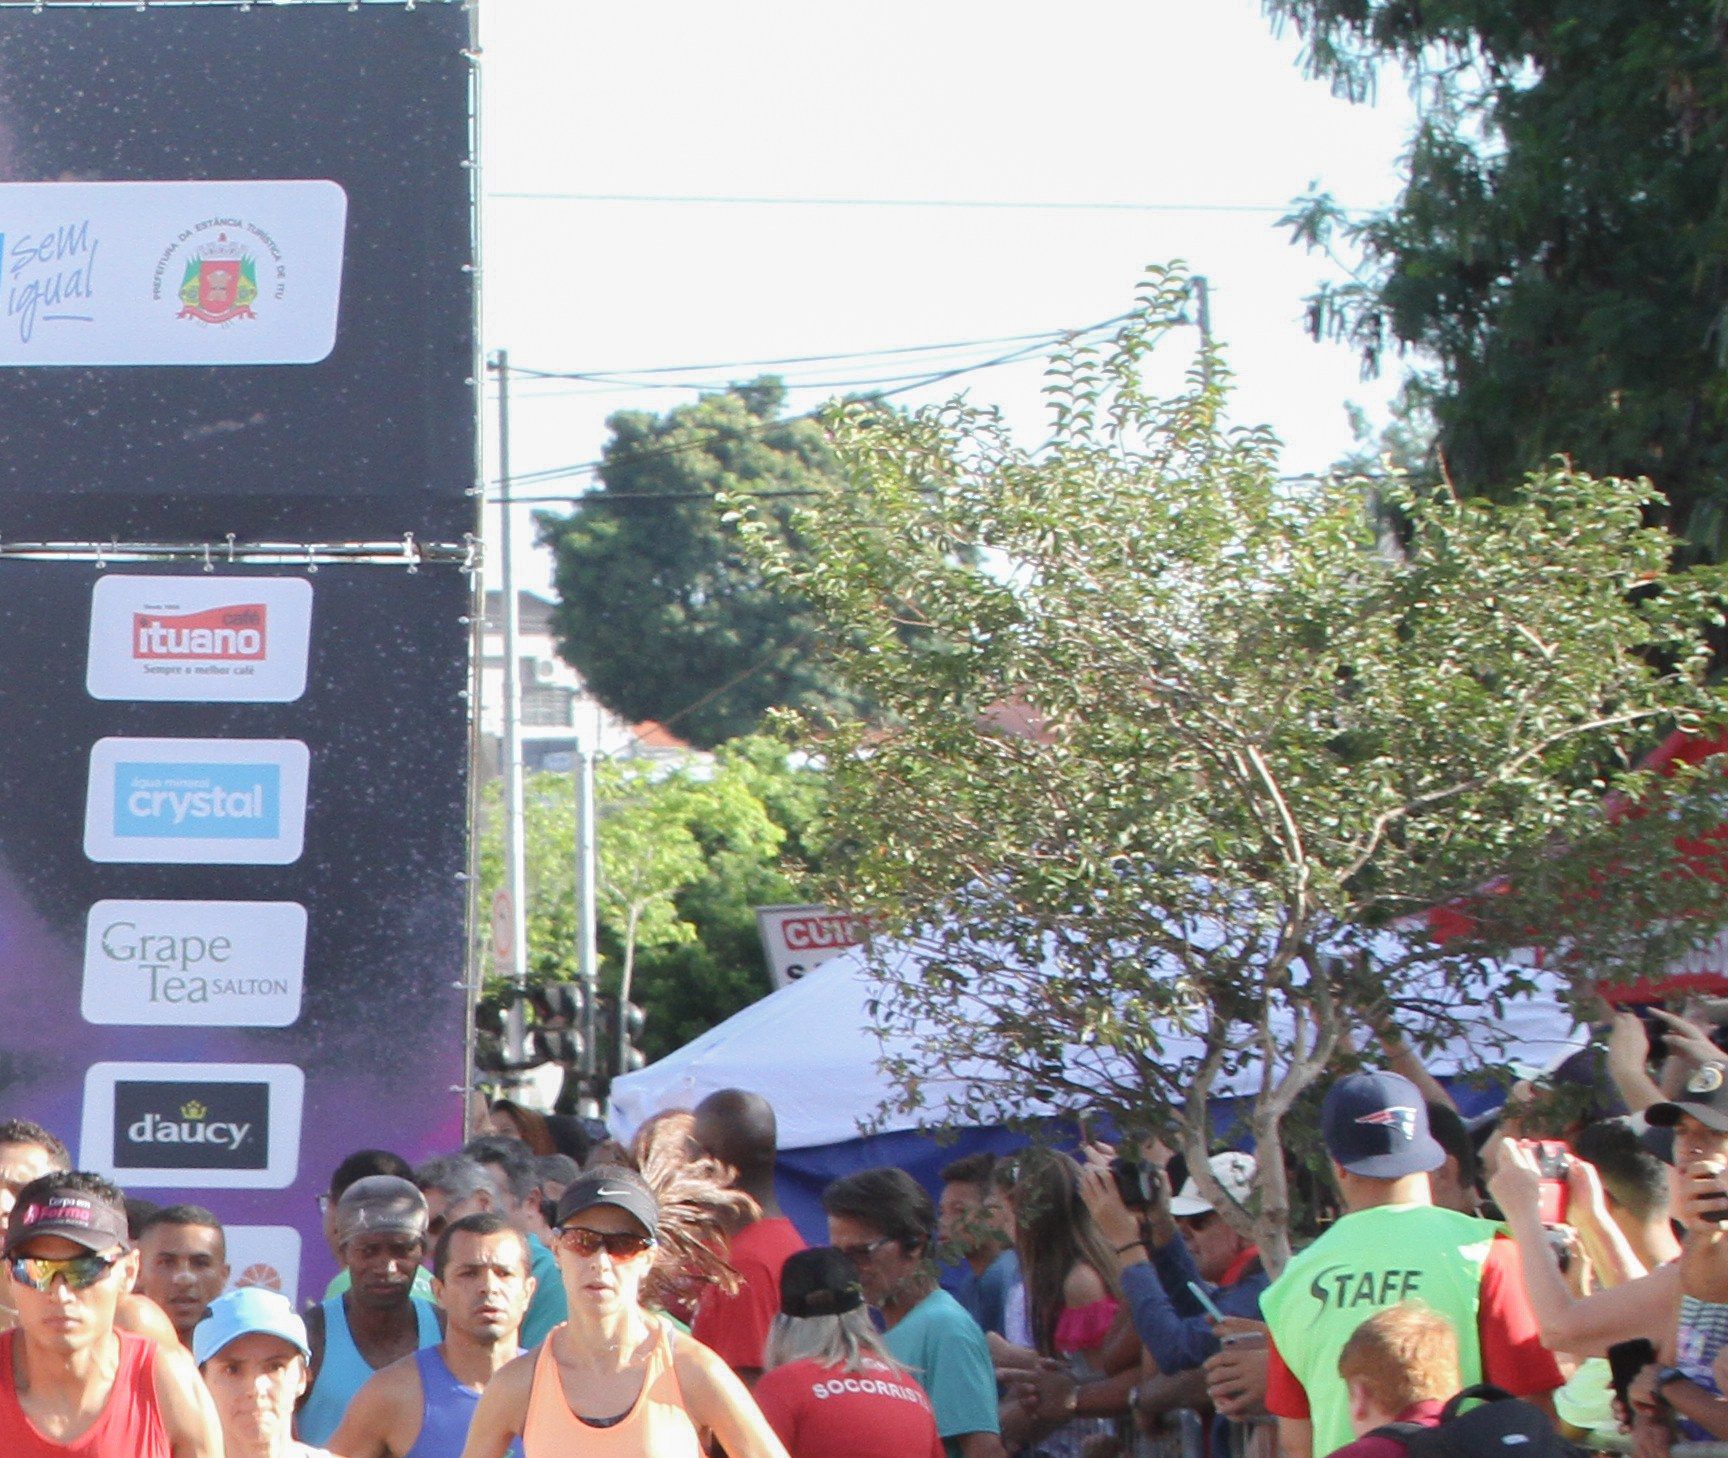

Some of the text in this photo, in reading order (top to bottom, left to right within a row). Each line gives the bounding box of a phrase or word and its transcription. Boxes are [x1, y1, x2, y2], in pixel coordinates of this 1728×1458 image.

[178, 230, 193, 242] DA
[195, 216, 243, 232] ESTÂNCIA
[10, 220, 89, 273] sem
[8, 239, 98, 343] igual
[153, 243, 178, 301] PREFEITURA
[277, 265, 286, 278] DE
[275, 284, 285, 300] ITU
[139, 617, 261, 655] ituano
[128, 784, 263, 825] crystal
[102, 921, 231, 971] Grape
[138, 964, 287, 1003] Tea SALTON
[128, 1113, 250, 1149] d'aucy
[1310, 1265, 1423, 1322] STAFF
